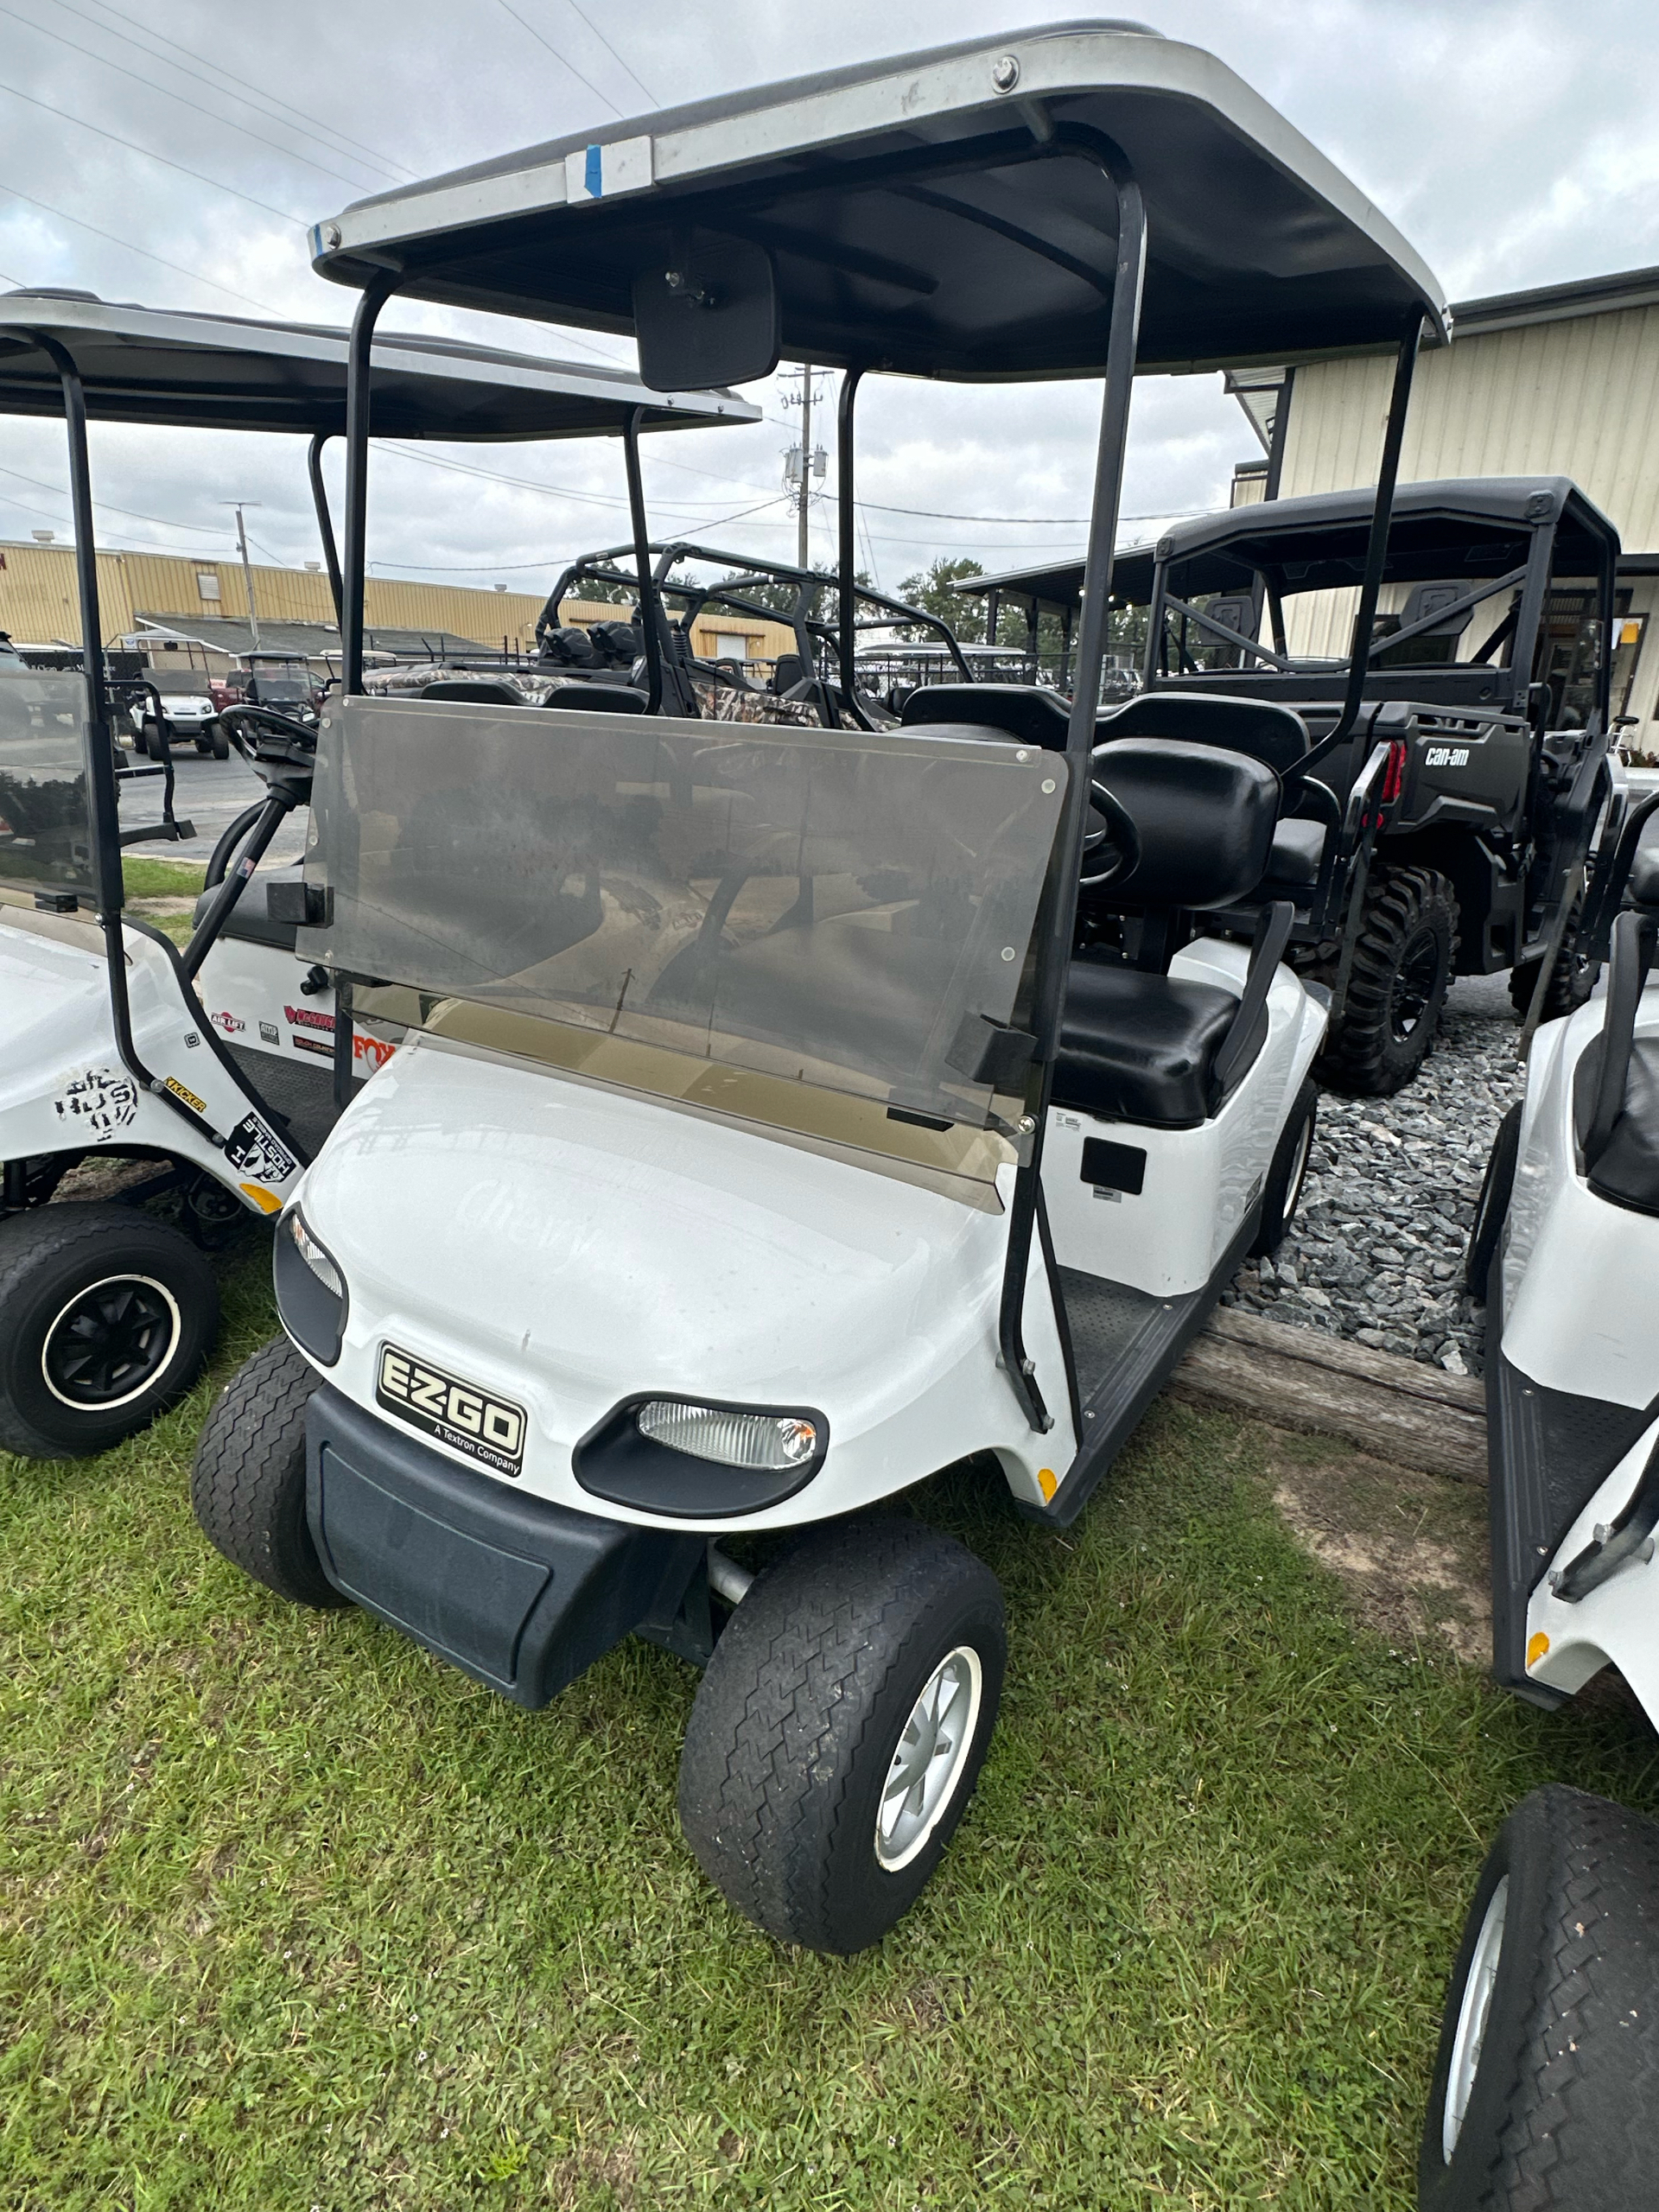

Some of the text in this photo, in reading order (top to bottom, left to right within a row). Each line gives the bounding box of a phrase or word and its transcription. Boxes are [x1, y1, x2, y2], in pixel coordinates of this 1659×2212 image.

[212, 1014, 245, 1030] AIR LIFT
[353, 1034, 396, 1072] FOX
[171, 1082, 206, 1112] KICKER
[243, 1119, 290, 1174] HOSTILE
[383, 1352, 520, 1451] EZGO
[434, 1425, 519, 1475] A Textron Company
